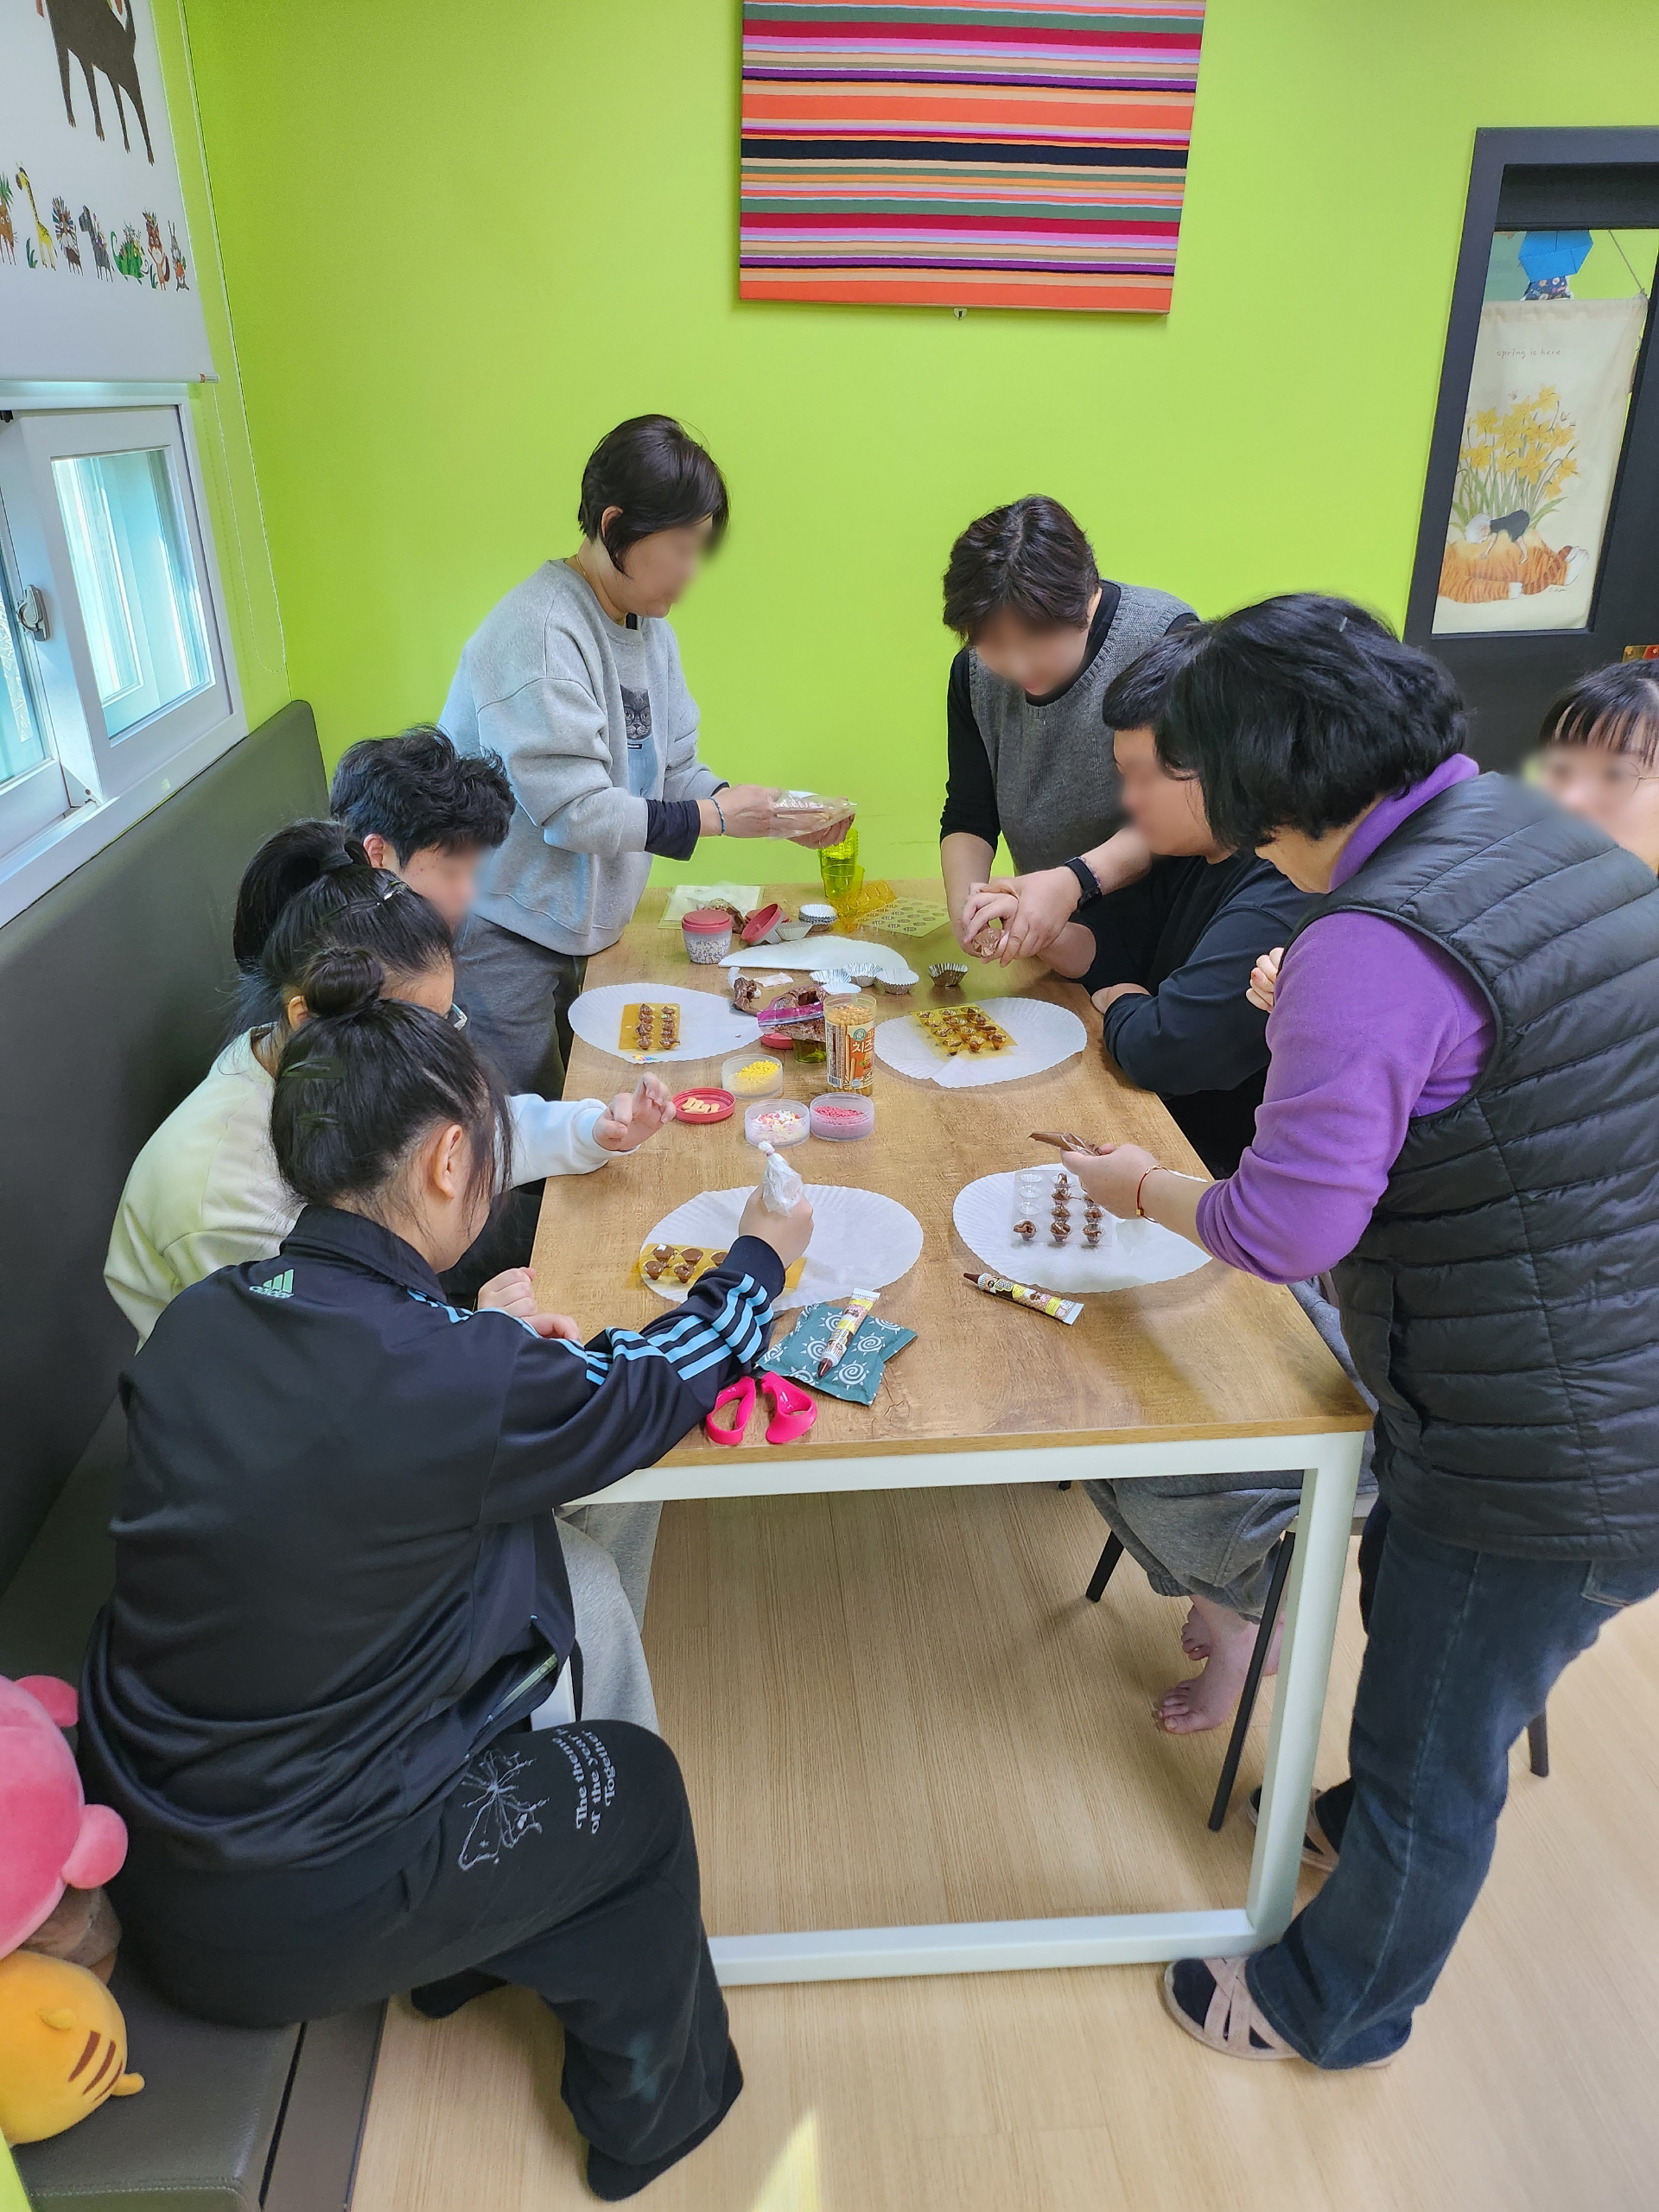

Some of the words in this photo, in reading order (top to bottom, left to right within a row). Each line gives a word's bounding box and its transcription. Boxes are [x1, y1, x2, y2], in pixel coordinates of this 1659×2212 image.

[1496, 348, 1526, 359] spring
[569, 1735, 599, 1766] year
[582, 1730, 616, 1807] Together
[591, 1770, 601, 1804] the
[576, 1785, 588, 1829] The
[591, 1810, 601, 1834] of
